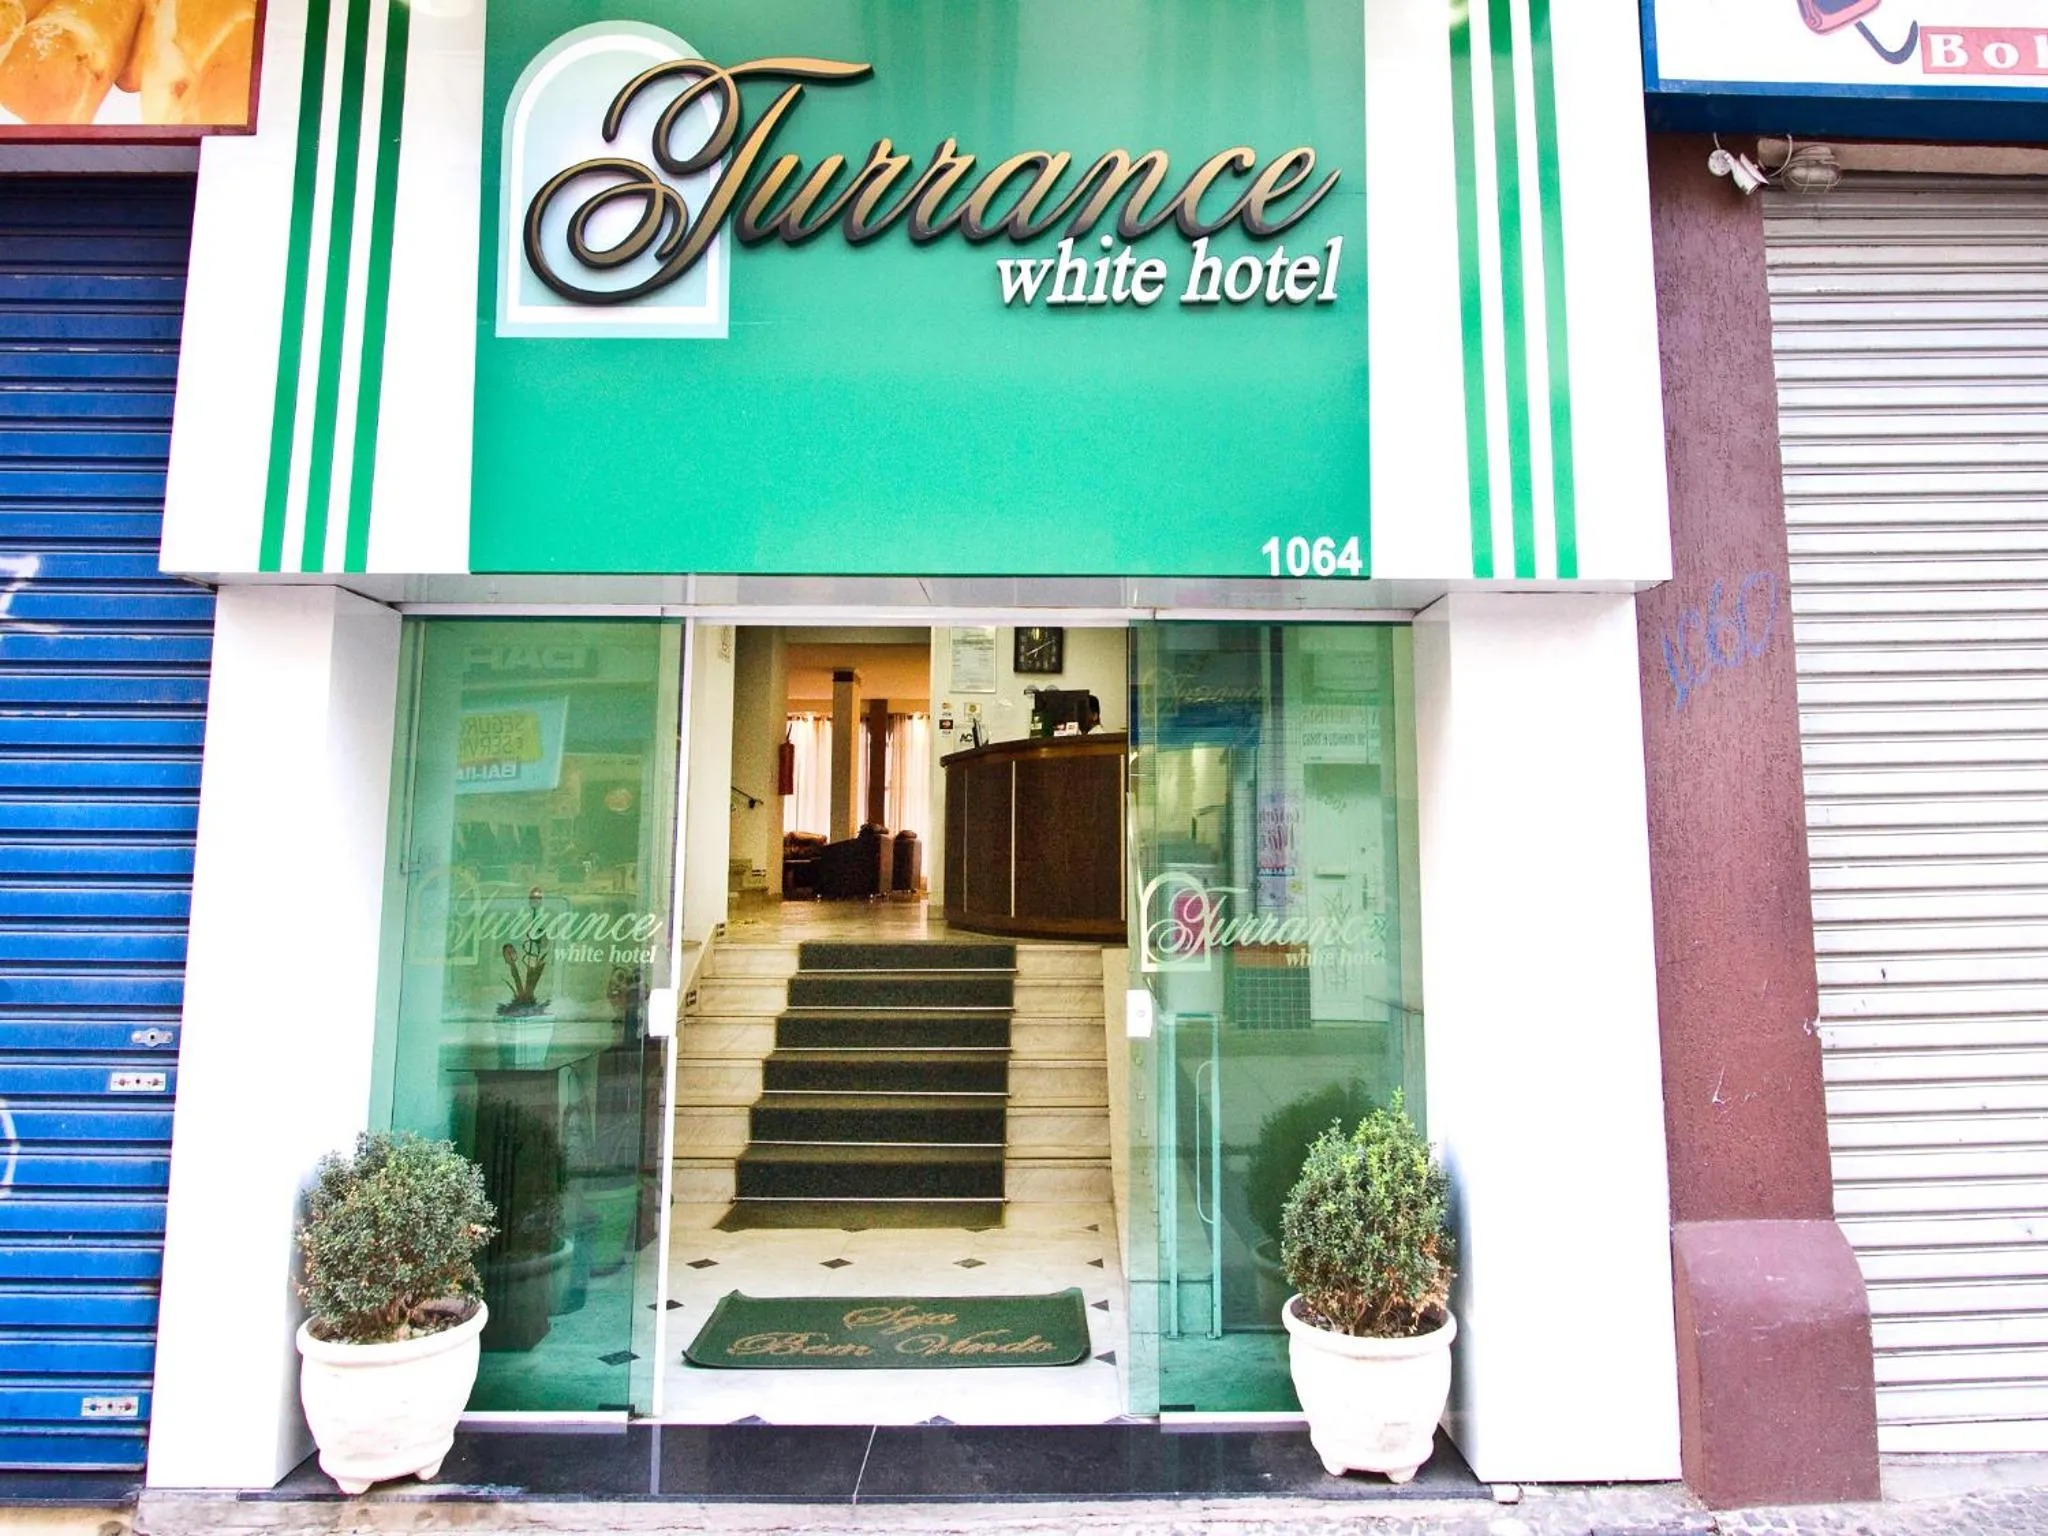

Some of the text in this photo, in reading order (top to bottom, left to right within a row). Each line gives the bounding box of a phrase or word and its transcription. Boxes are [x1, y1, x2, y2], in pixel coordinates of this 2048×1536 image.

[523, 56, 1341, 306] Turrance
[996, 234, 1344, 306] white hotel
[1262, 535, 1363, 577] 1064
[554, 944, 657, 963] white hotel
